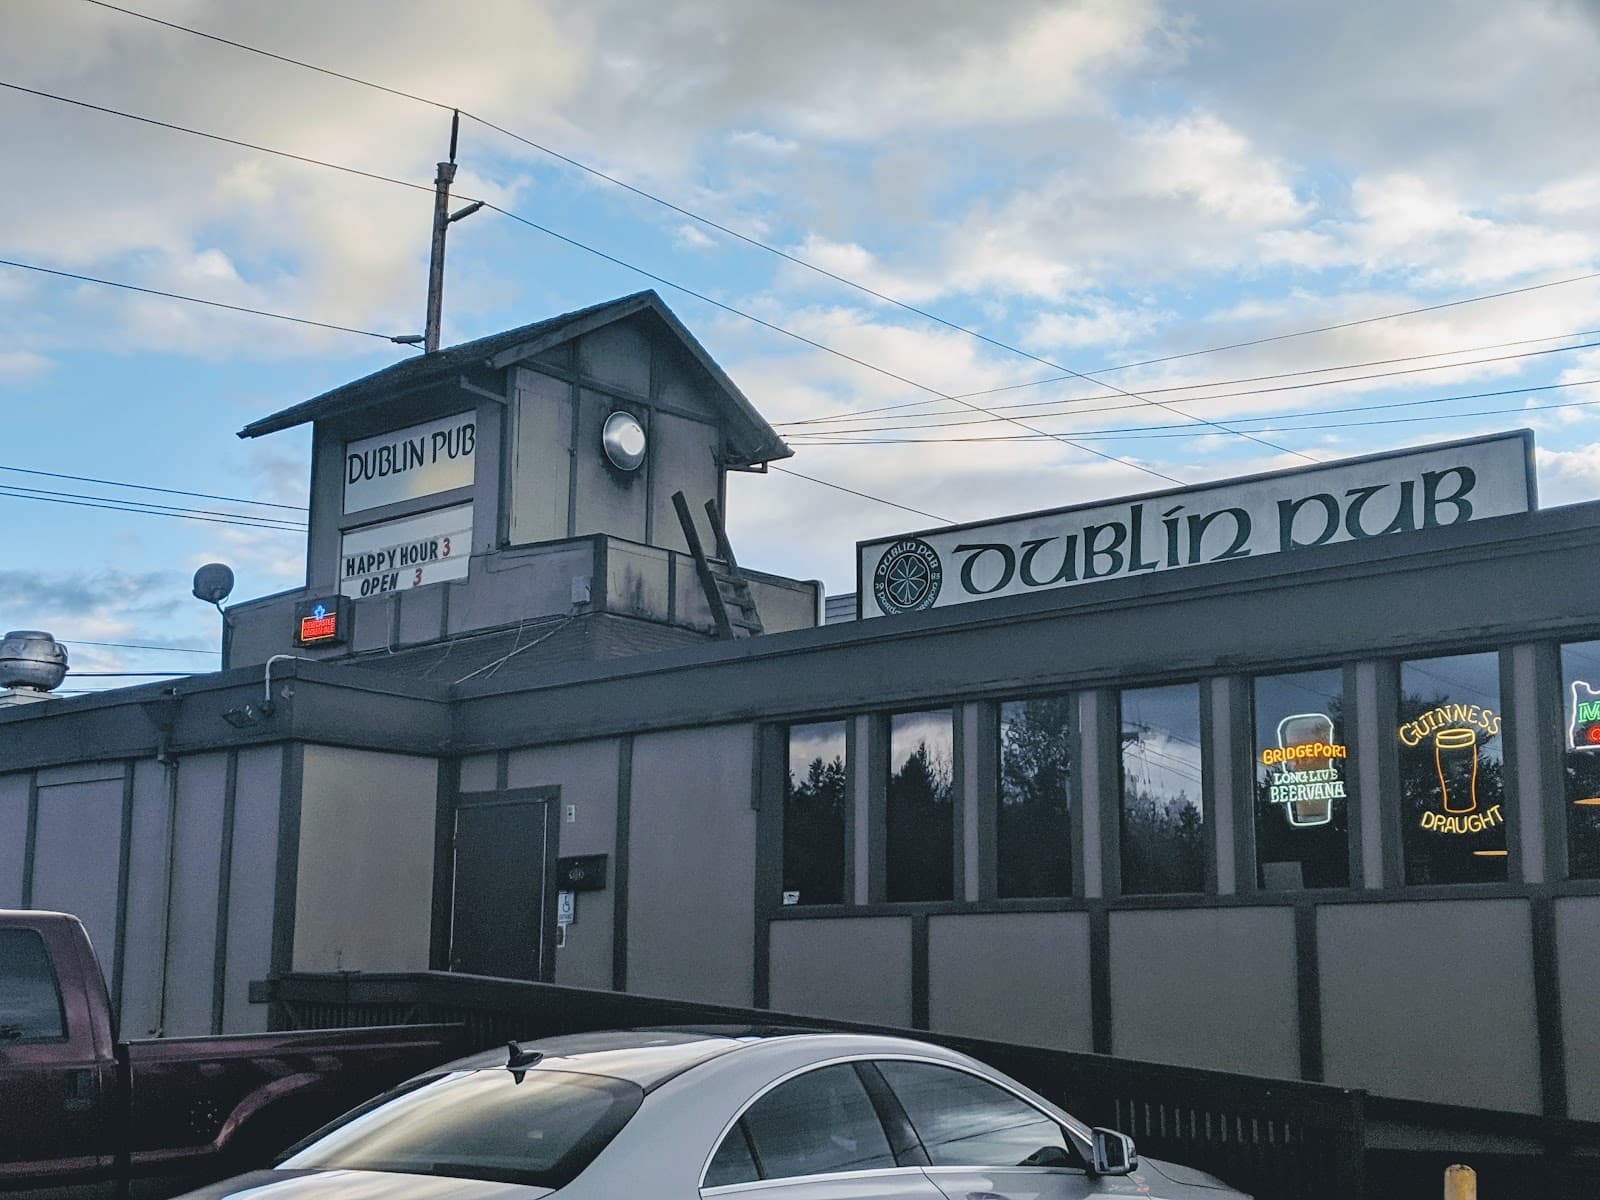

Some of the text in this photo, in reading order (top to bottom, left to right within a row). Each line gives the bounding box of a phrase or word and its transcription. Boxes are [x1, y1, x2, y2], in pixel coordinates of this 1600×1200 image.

[347, 423, 475, 484] DUBLIN PUB
[1276, 466, 1477, 553] PUB
[346, 537, 451, 576] HAPPY HOUR 3
[360, 567, 423, 597] OPEN 3
[1399, 703, 1502, 746] GUINNESS
[1262, 742, 1347, 766] BRIDGEPORT
[1270, 781, 1347, 803] BEERVANA
[1273, 768, 1338, 786] LONG LIVE
[1421, 804, 1504, 834] DRAUGHT
